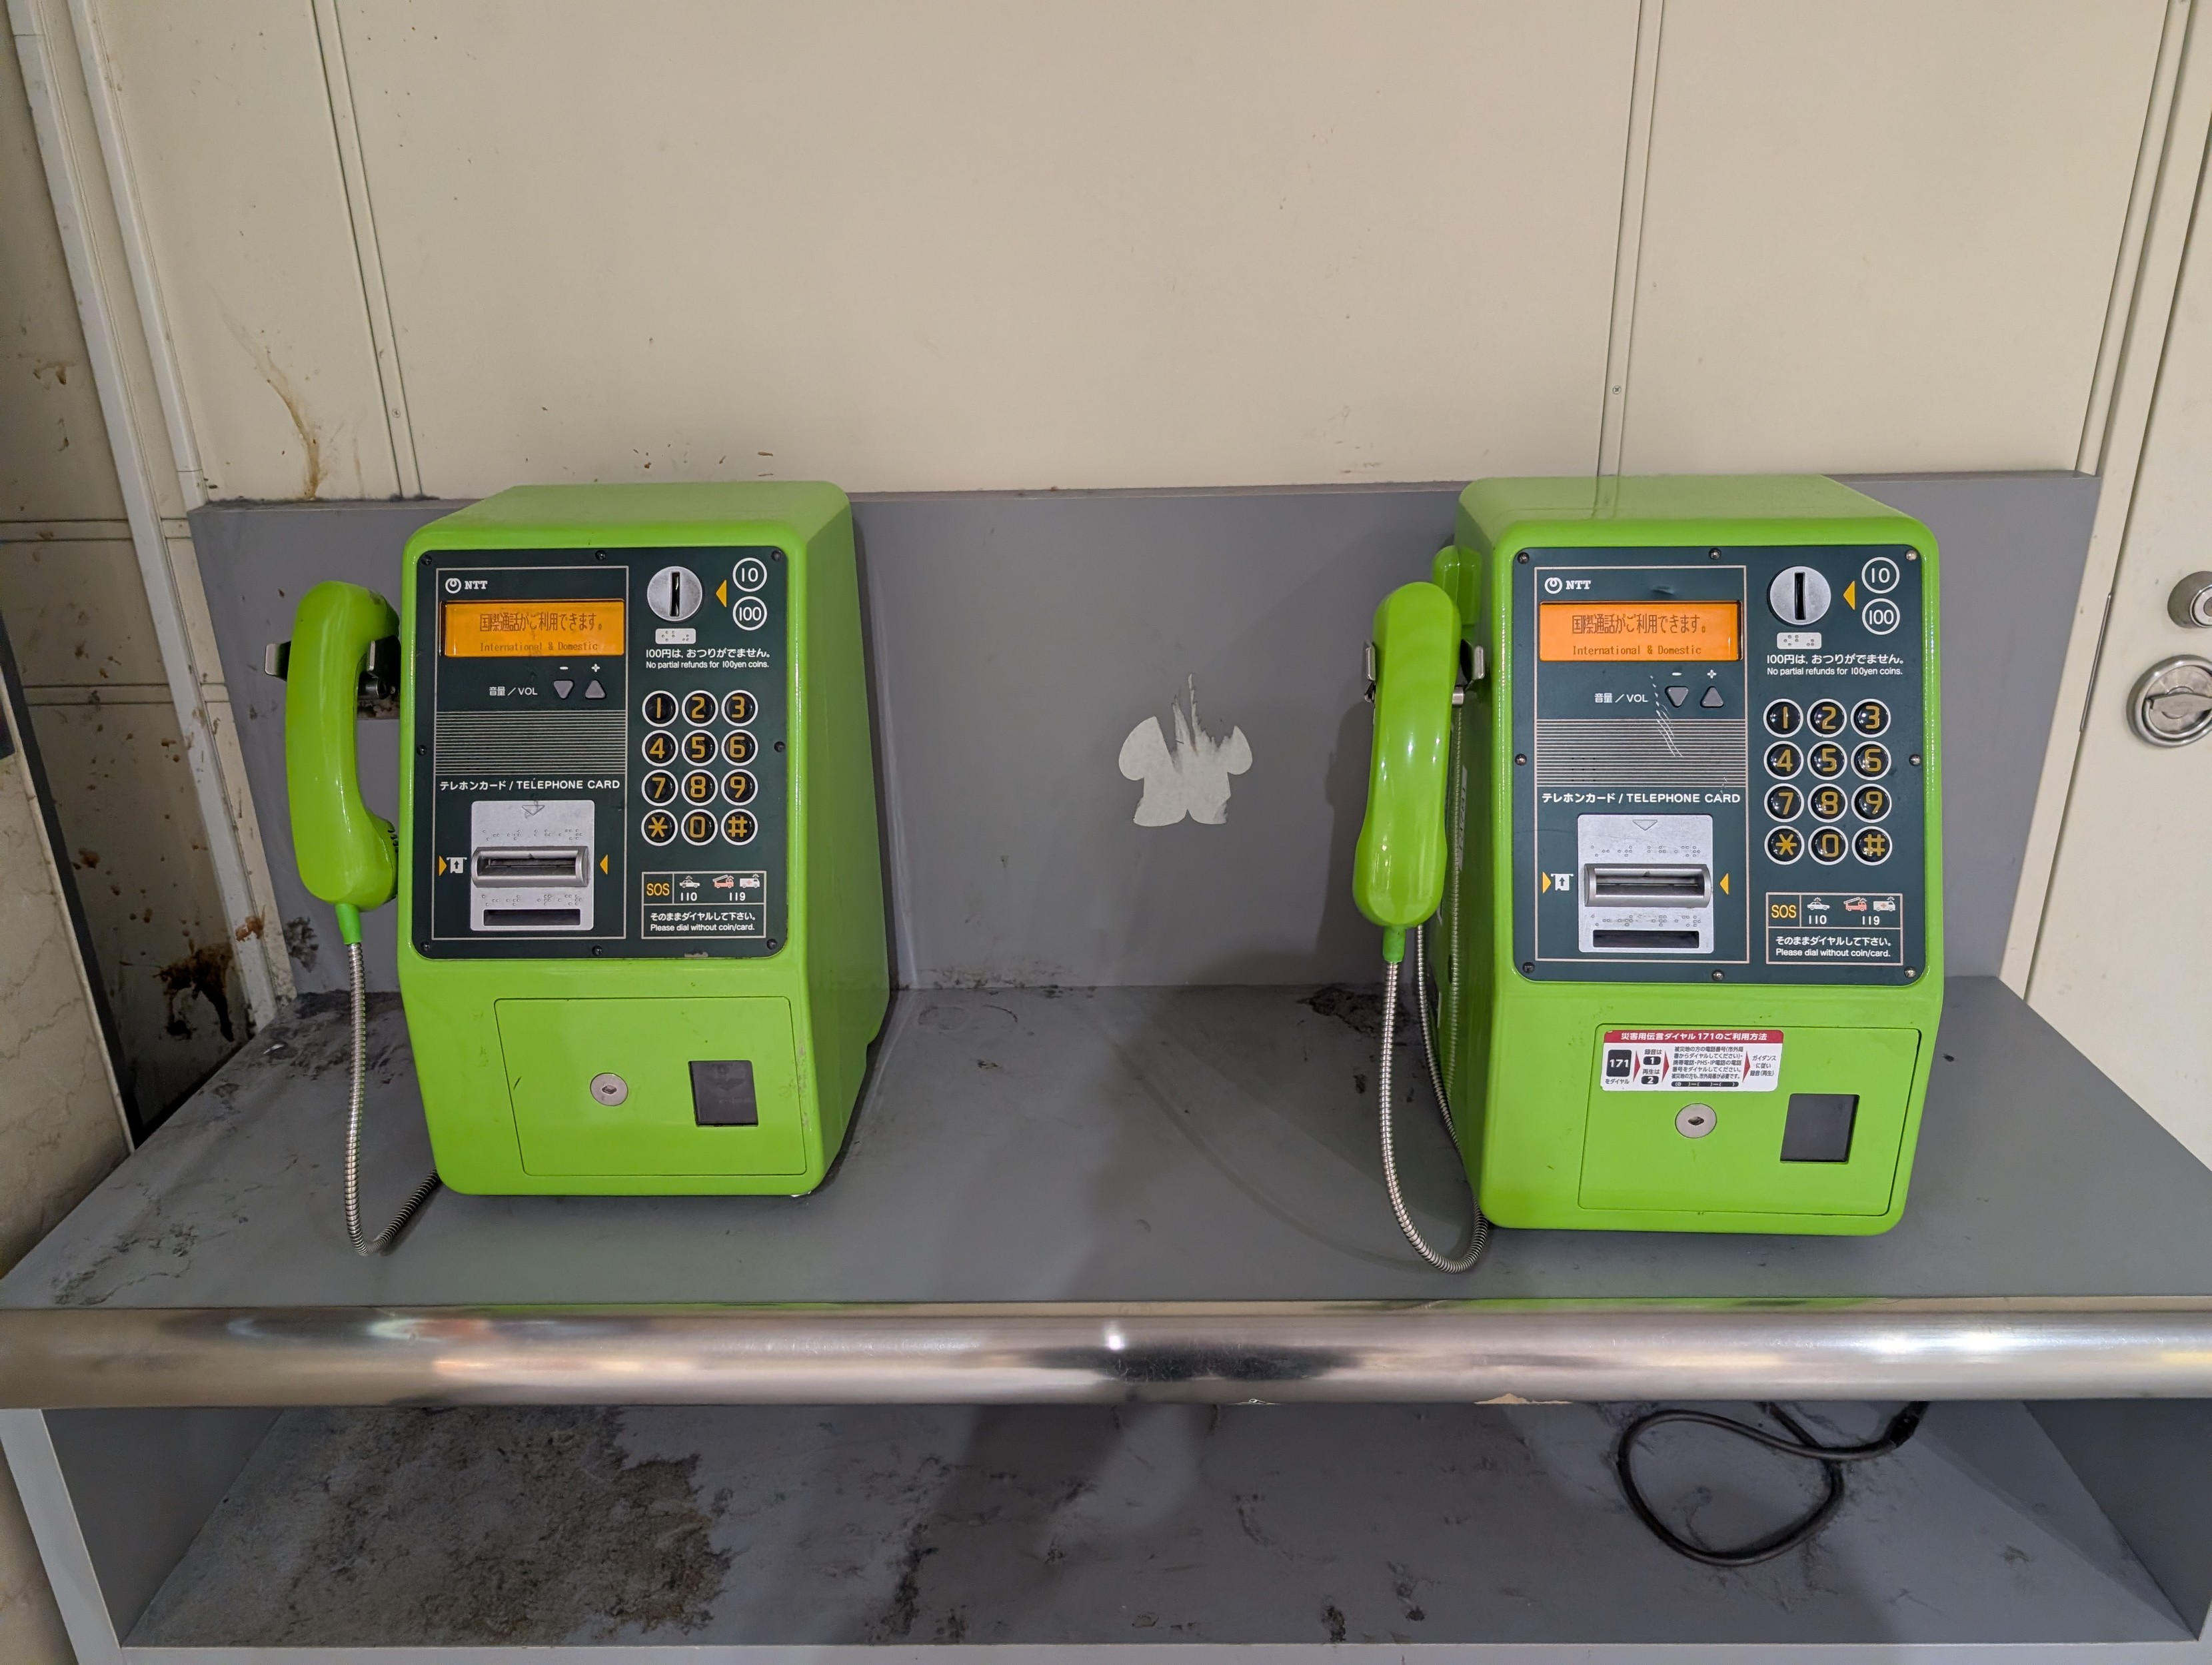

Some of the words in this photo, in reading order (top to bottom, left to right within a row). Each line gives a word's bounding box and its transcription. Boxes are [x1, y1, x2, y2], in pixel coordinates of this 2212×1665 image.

[741, 568, 758, 582] 10
[1871, 568, 1890, 584] 10
[465, 580, 488, 590] NTT
[1566, 580, 1592, 590] NTT
[739, 606, 762, 621] 100
[1869, 609, 1894, 625] 100
[480, 612, 602, 632] 国際通話がご利用できます。
[1572, 613, 1706, 634] 国際通話がご利用できます。
[480, 642, 543, 652] International
[548, 642, 554, 651] &
[558, 642, 598, 651] Domestic
[1573, 645, 1641, 656] International
[1647, 645, 1653, 654] &
[1658, 645, 1701, 655] Domestic
[658, 661, 679, 670] partial
[722, 660, 747, 670] 100yen
[1780, 667, 1803, 676] partial
[1851, 667, 1877, 676] 100yen
[489, 686, 506, 696] 音量
[517, 687, 538, 696] VOL
[1594, 693, 1613, 704] 音量
[1626, 694, 1648, 703] VOL
[691, 696, 704, 719] 2
[732, 696, 745, 718] 3
[1821, 706, 1836, 730] 2
[1865, 706, 1879, 729] 3
[649, 738, 665, 759] 4
[692, 736, 705, 758] 5
[730, 736, 746, 758] 6
[1777, 749, 1793, 772] 4
[1821, 748, 1837, 772] 5
[1864, 748, 1881, 772] 6
[439, 780, 507, 791] テレホンカード
[517, 780, 583, 790] TELEPHONE
[587, 780, 620, 790] CARD
[652, 777, 666, 799] 7
[690, 776, 706, 798] 8
[730, 776, 746, 799] 9
[1542, 793, 1616, 804] テレホンカード
[1626, 794, 1699, 803] TELEPHONE
[1704, 794, 1740, 803] CARD
[1779, 792, 1793, 815] 7
[1821, 791, 1838, 815] 8
[1865, 791, 1882, 814] 9
[690, 816, 705, 838] 0
[1822, 833, 1839, 857] 0
[646, 883, 670, 896] SOS
[680, 892, 697, 901] 110
[729, 891, 746, 901] 119
[650, 911, 756, 921] そのままダイヤルして下さい。
[1771, 904, 1796, 919] SOS
[1809, 915, 1827, 925] 110
[1862, 915, 1880, 925] 119
[1775, 936, 1891, 946] そのままダイヤルして下さい。
[1851, 949, 1891, 957] coin/card.
[1610, 1059, 1629, 1068] 171
